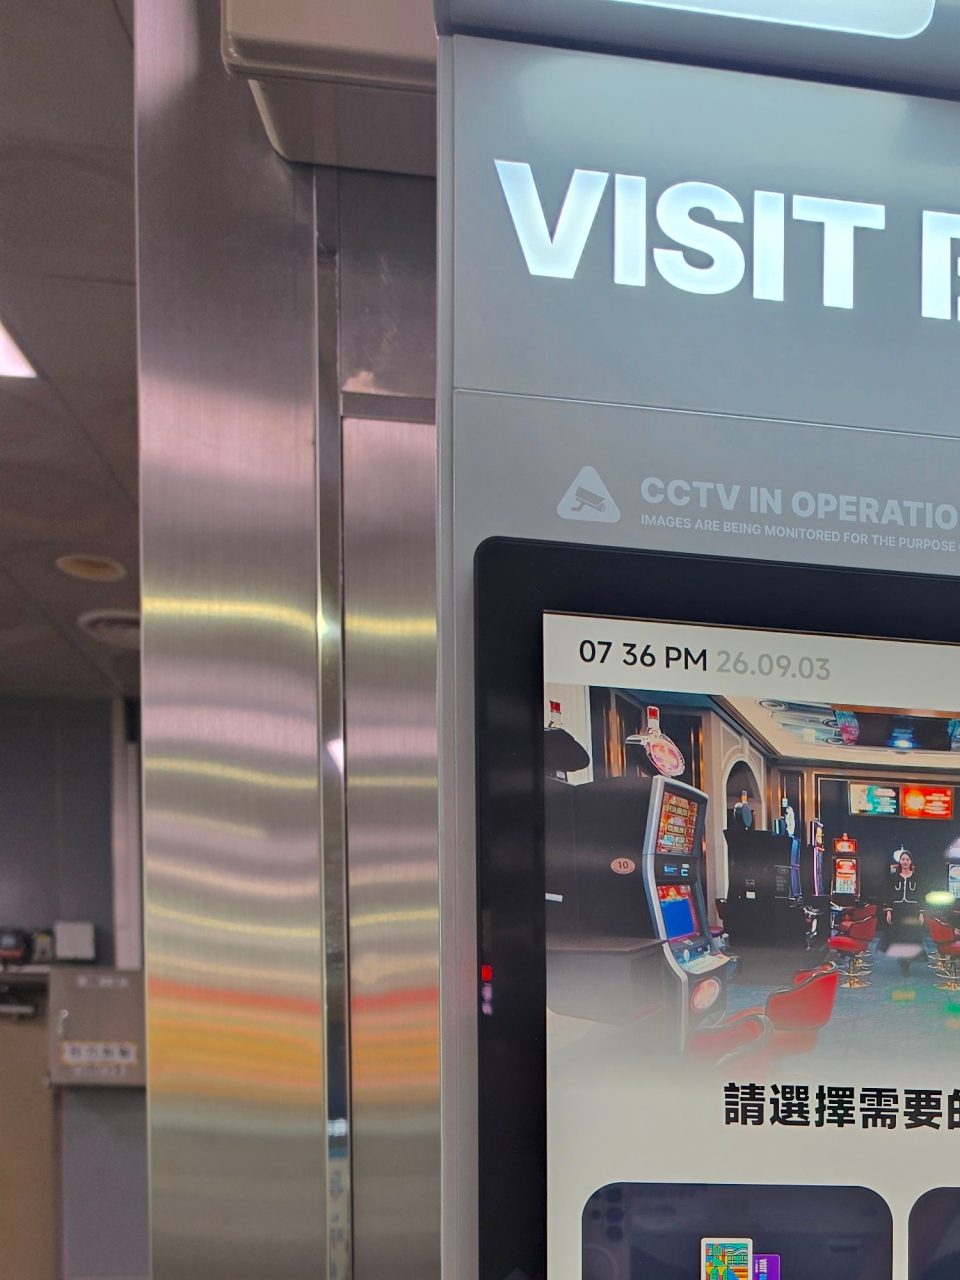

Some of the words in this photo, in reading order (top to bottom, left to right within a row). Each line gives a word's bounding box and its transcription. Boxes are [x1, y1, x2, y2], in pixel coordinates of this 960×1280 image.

[494, 158, 886, 310] VISIT
[641, 477, 740, 510] CCTV
[750, 486, 782, 515] IN
[641, 514, 691, 529] IMAGES
[695, 518, 720, 532] ARE
[723, 521, 762, 535] BEING
[764, 525, 840, 542] MONITORED
[843, 532, 868, 545] FOR
[871, 534, 896, 547] THE
[899, 536, 956, 552] PURPOSE
[579, 639, 612, 664] 07
[622, 642, 656, 667] 36
[665, 646, 707, 671] PM
[716, 651, 830, 680] 26.09.03
